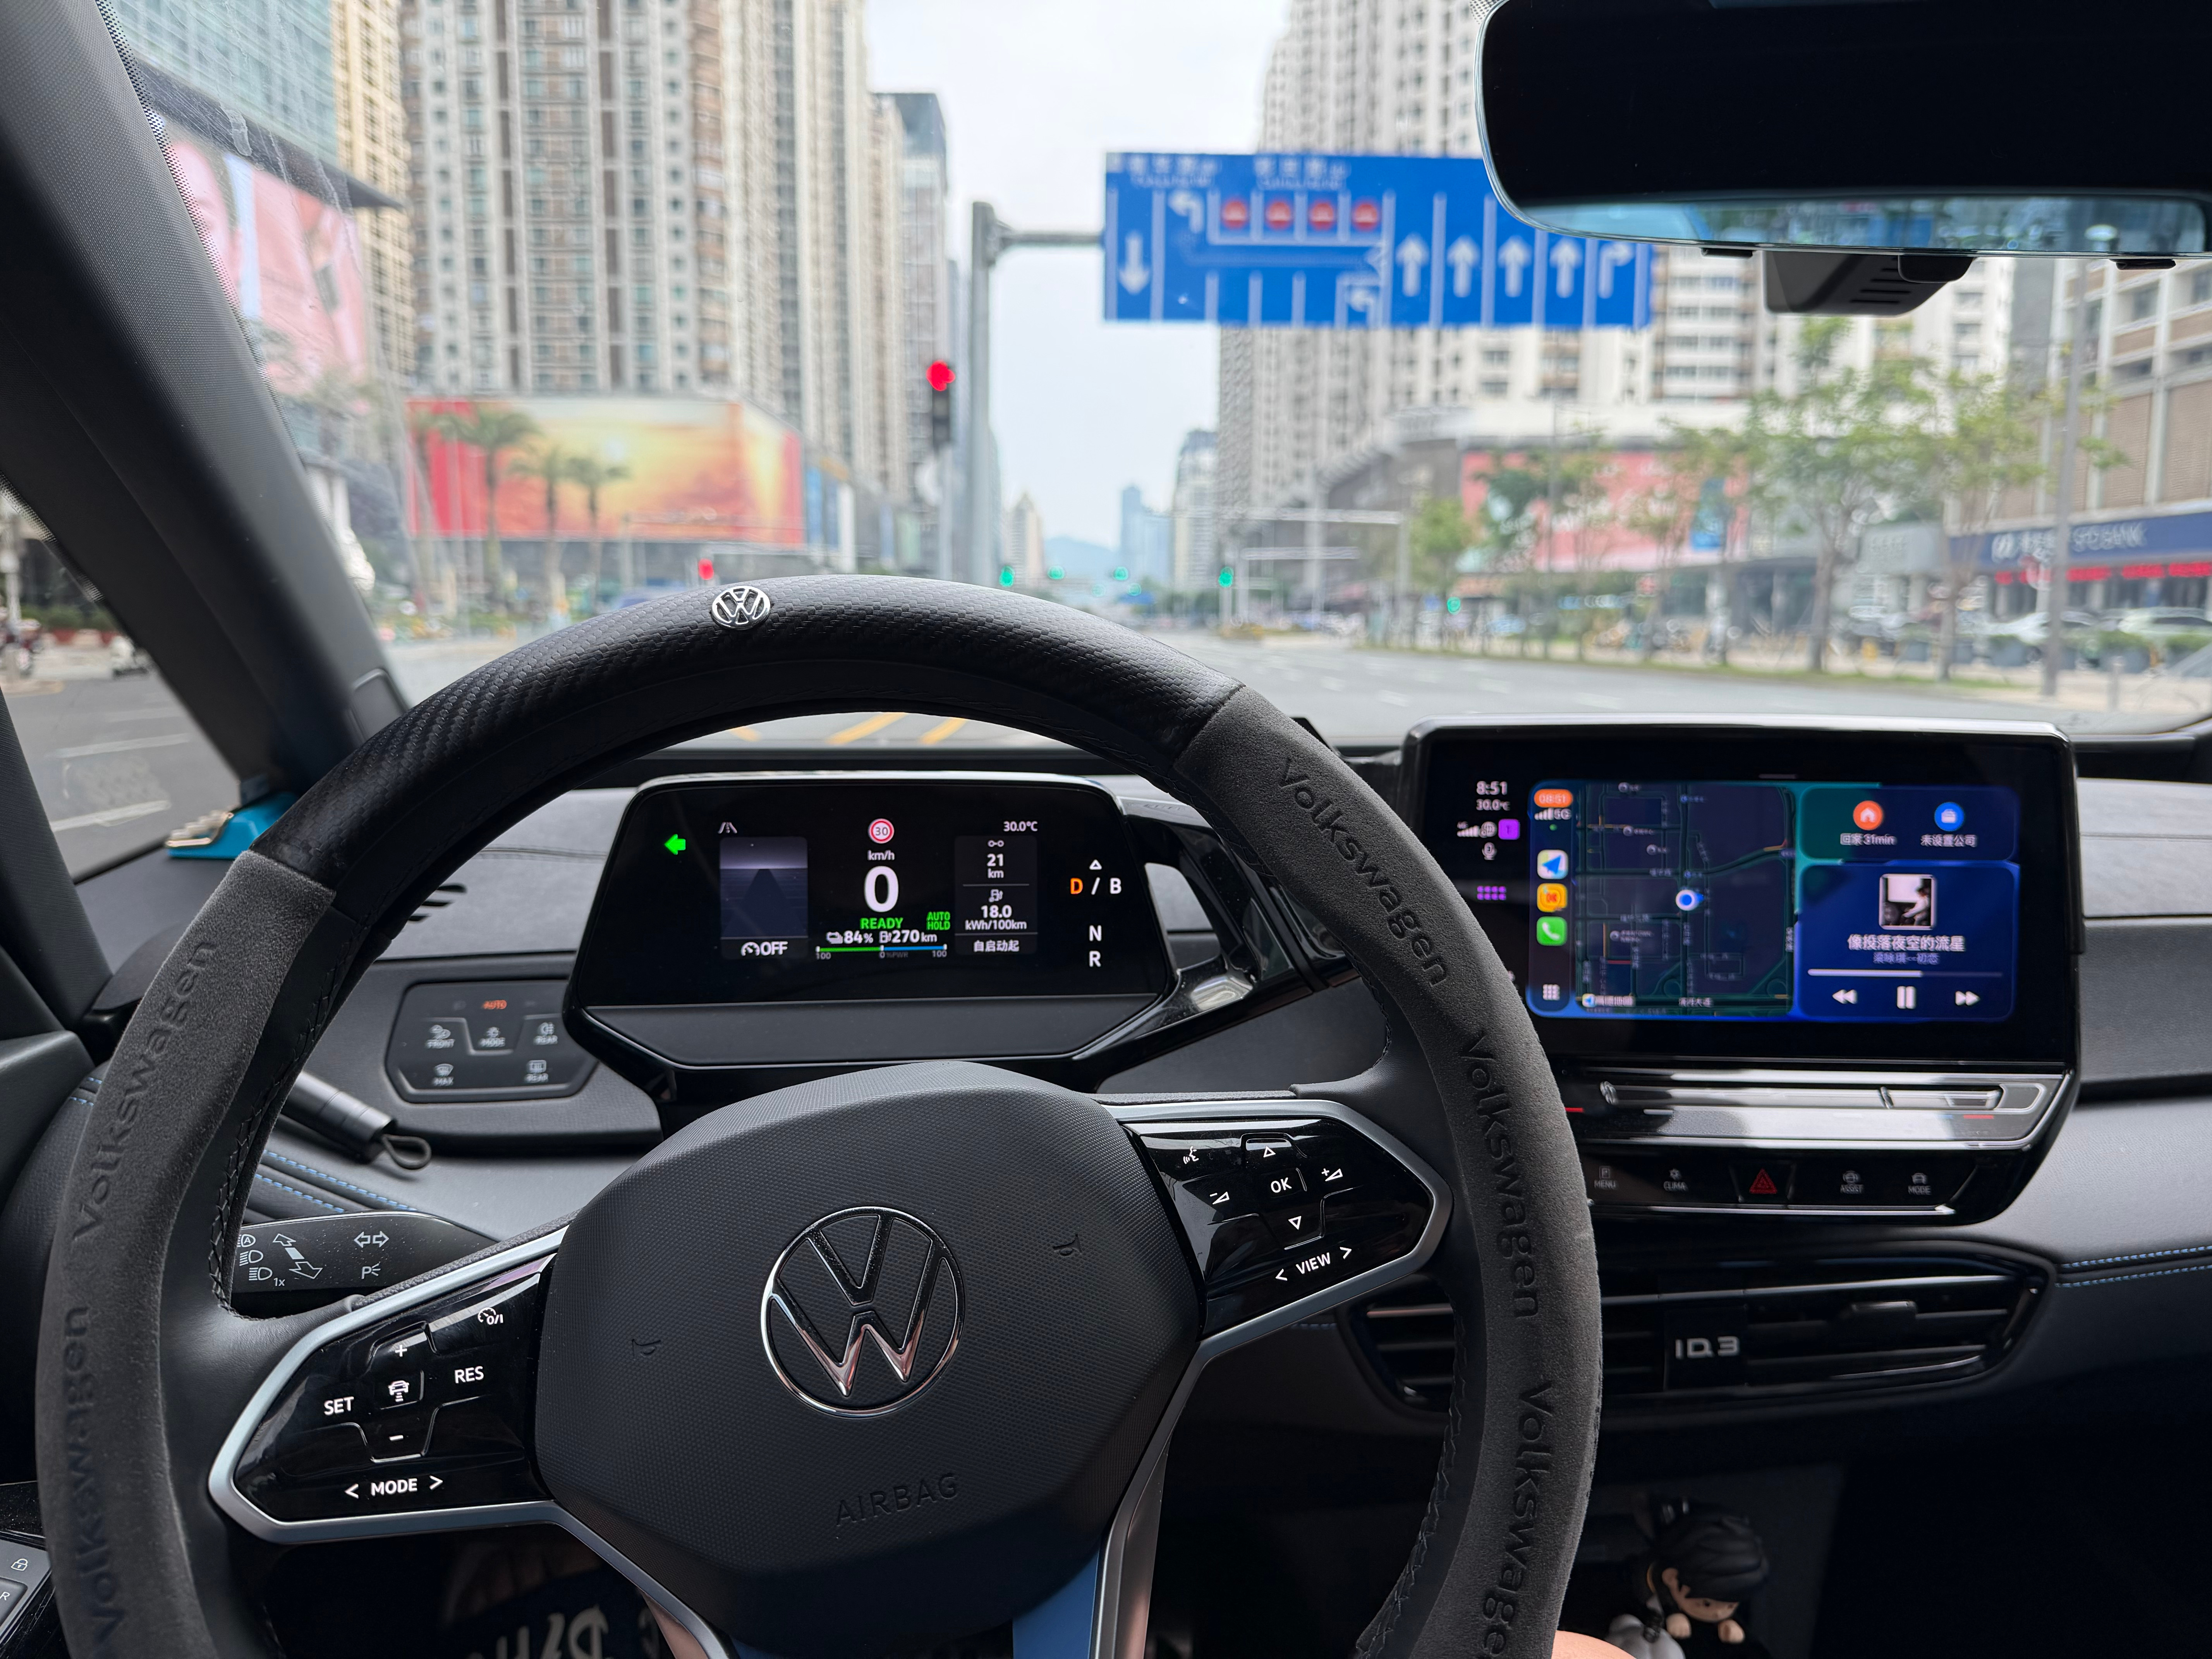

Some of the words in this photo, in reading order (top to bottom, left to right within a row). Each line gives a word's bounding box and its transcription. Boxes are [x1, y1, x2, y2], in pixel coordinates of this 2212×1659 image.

[1476, 781, 1508, 795] 8:51
[1554, 808, 1571, 820] 5G
[875, 826, 889, 836] 30
[1003, 821, 1038, 831] 30.0°C
[1840, 833, 1863, 845] 回家
[1920, 834, 1977, 847] 未设置公司
[867, 850, 895, 860] km/h
[987, 854, 1004, 867] 21
[988, 868, 1004, 878] km
[1279, 757, 1447, 987] Volkswagen
[864, 866, 899, 912] 0
[1070, 878, 1083, 894] D
[1110, 878, 1122, 894] B
[927, 911, 951, 921] AUTO
[981, 905, 1012, 918] 18.0
[860, 917, 903, 929] READY
[926, 921, 951, 931] HOLD
[965, 920, 1027, 930] kWh/100km
[1089, 925, 1102, 941] N
[760, 941, 788, 956] OFF
[974, 939, 1020, 953] 自启动起
[1089, 951, 1101, 967] R
[482, 1000, 507, 1010] AUTO
[426, 1039, 455, 1049] FRONT
[479, 1037, 505, 1047] MODE
[73, 942, 217, 1240] Volkswagen
[1461, 1032, 1538, 1317] Volkswagen
[1271, 1177, 1292, 1193] OK
[1594, 1180, 1618, 1190] MENU
[1908, 1185, 1932, 1195] MODE
[1296, 1252, 1331, 1275] VIEW
[273, 1278, 285, 1287] 1x
[454, 1366, 484, 1384] RES
[324, 1396, 354, 1416] SET
[64, 1306, 126, 1645] Volkswagen
[371, 1477, 418, 1496] MODE
[836, 1473, 959, 1527] AIRBAG
[1480, 1383, 1553, 1659] Volkswage
